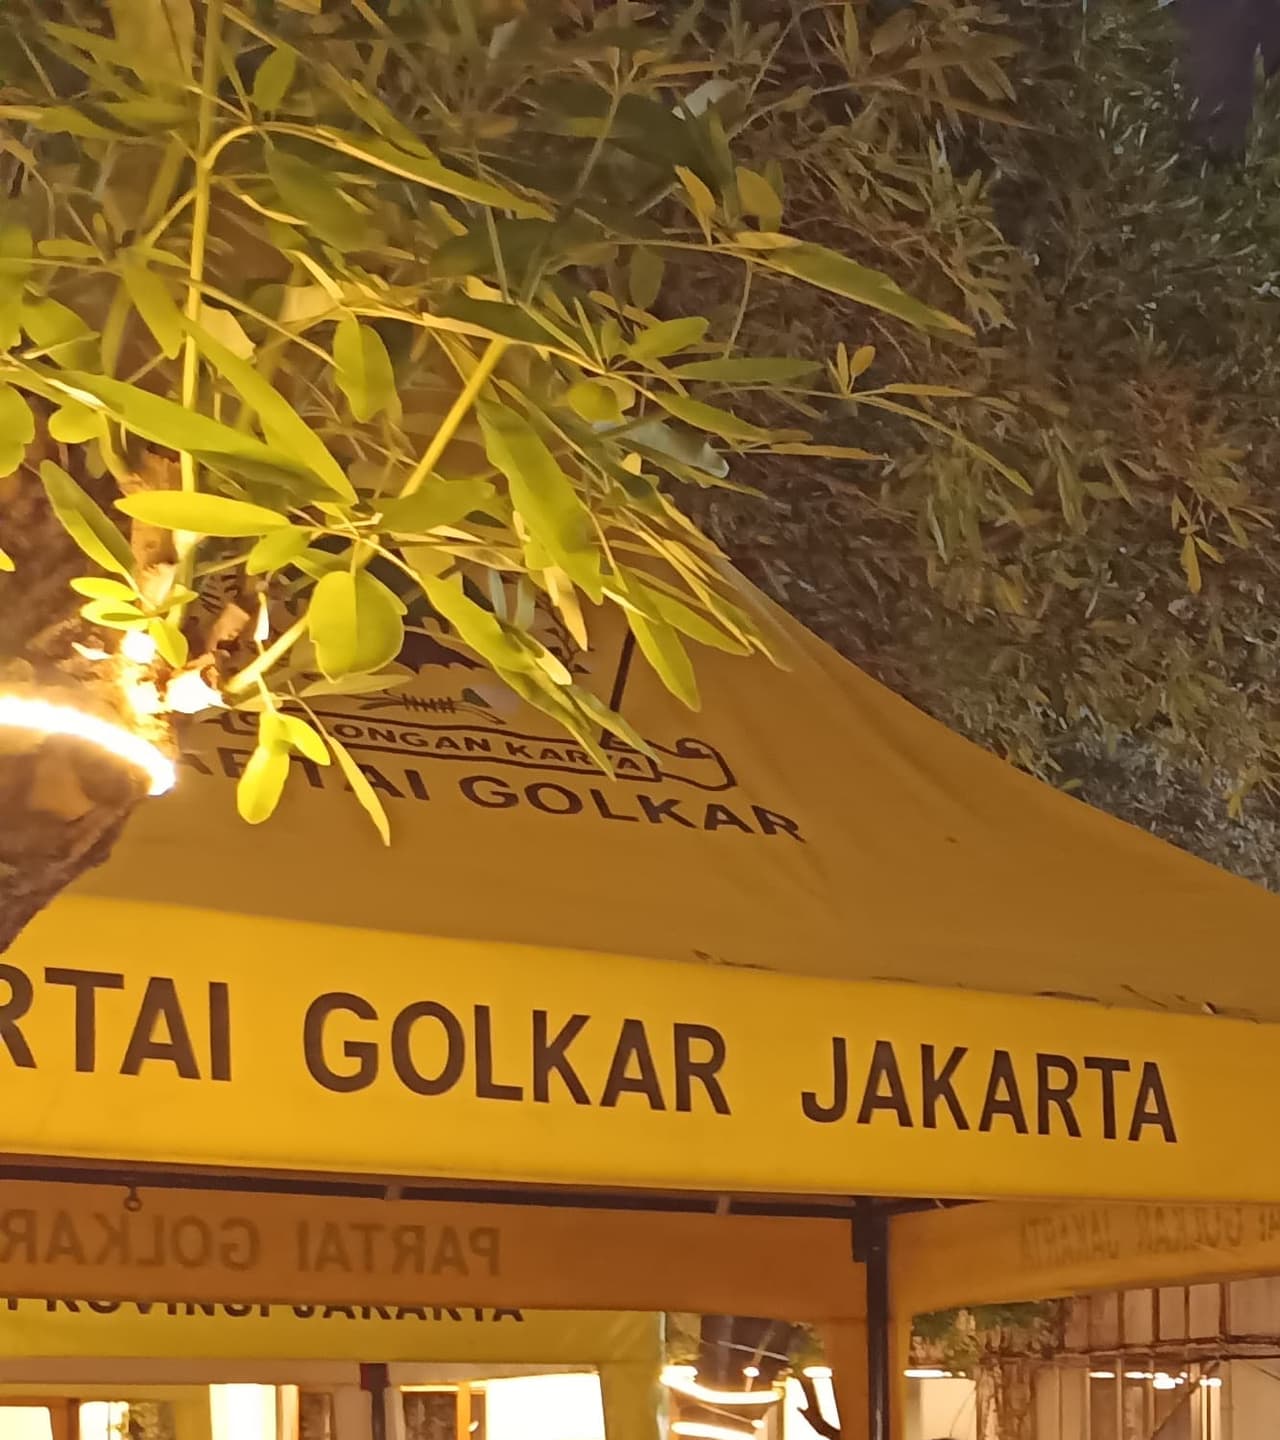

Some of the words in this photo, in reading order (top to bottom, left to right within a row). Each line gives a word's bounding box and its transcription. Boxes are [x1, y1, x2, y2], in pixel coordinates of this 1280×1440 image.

[505, 741, 643, 771] KARA
[458, 775, 807, 842] GOLKAR
[0, 963, 232, 1082] RTAI
[303, 991, 732, 1116] GOLKAR
[801, 1036, 1178, 1144] JAKARTA
